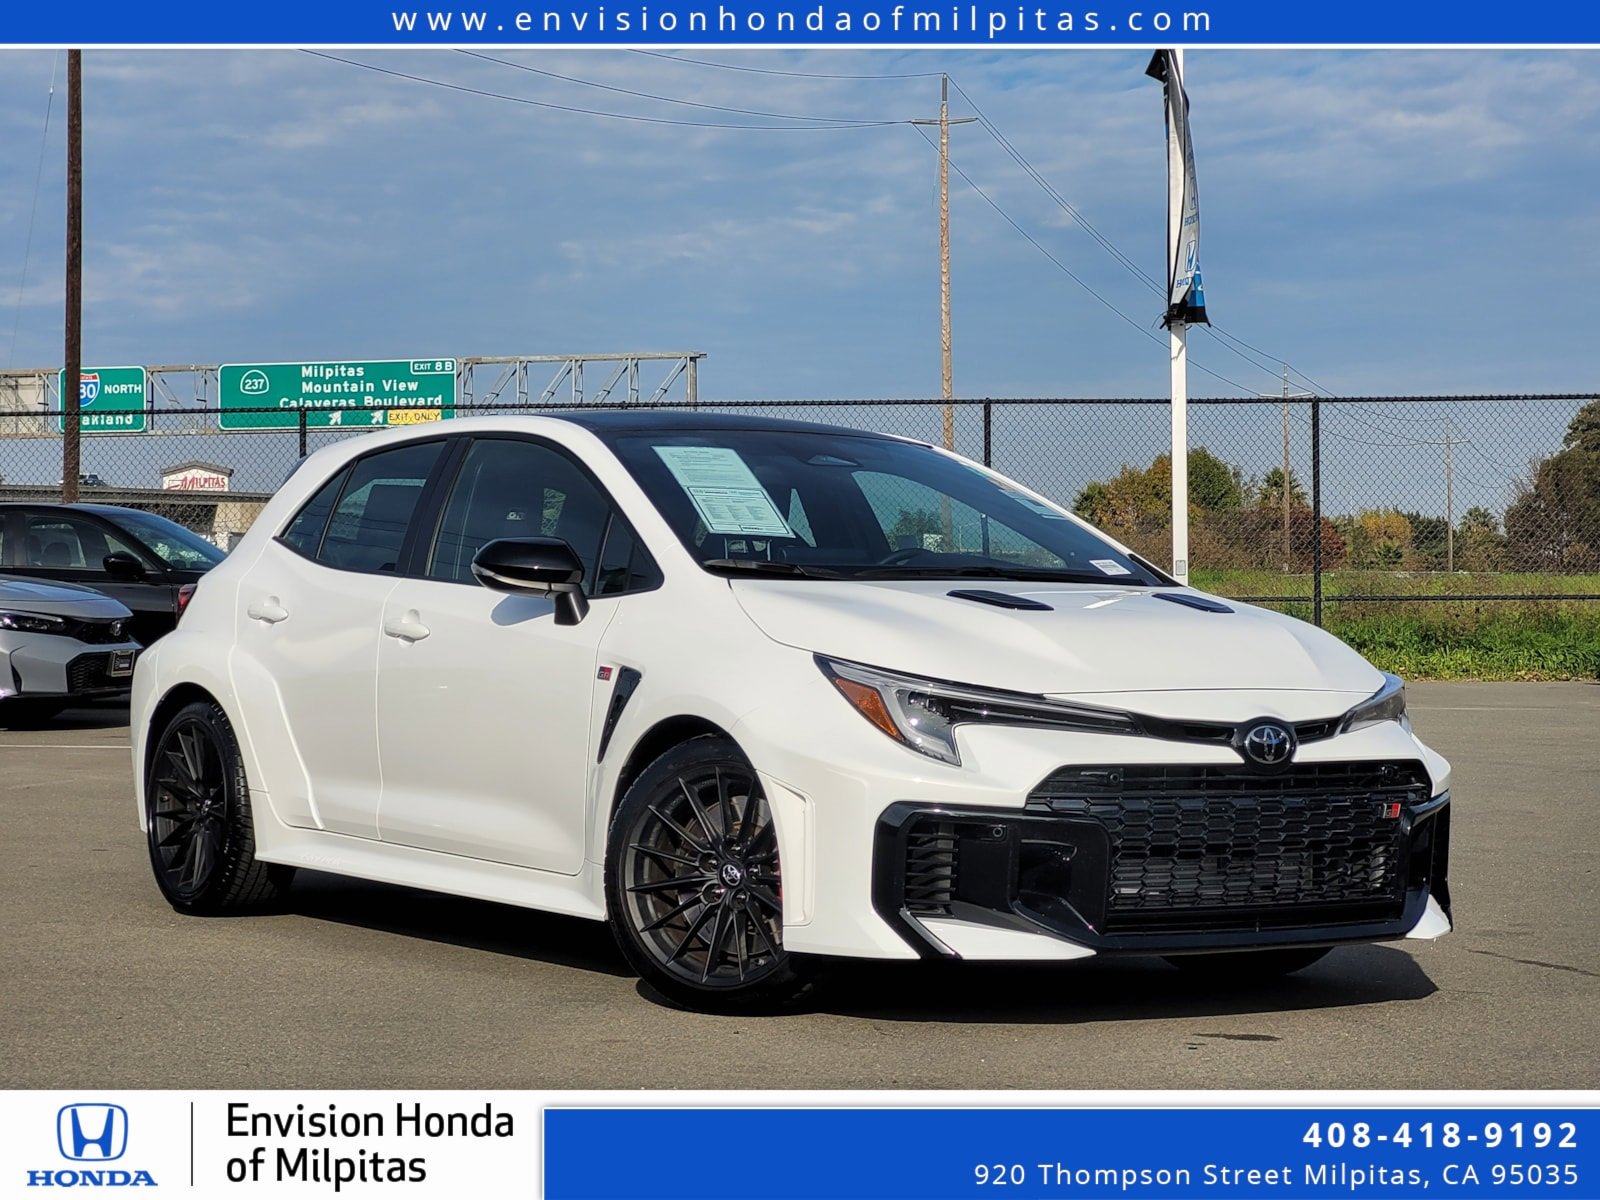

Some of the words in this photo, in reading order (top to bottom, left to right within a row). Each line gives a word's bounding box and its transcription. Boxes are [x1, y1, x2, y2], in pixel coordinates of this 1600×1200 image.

[301, 364, 365, 380] Milpitas
[414, 363, 432, 371] EXIT
[104, 384, 142, 394] NORTH
[244, 378, 265, 390] 237
[302, 380, 375, 394] Mountain
[382, 379, 419, 392] View
[79, 383, 97, 399] 80
[279, 397, 356, 409] Calaveras
[364, 394, 443, 407] Boulevard
[81, 413, 134, 426] akland
[414, 413, 440, 421] ONLY
